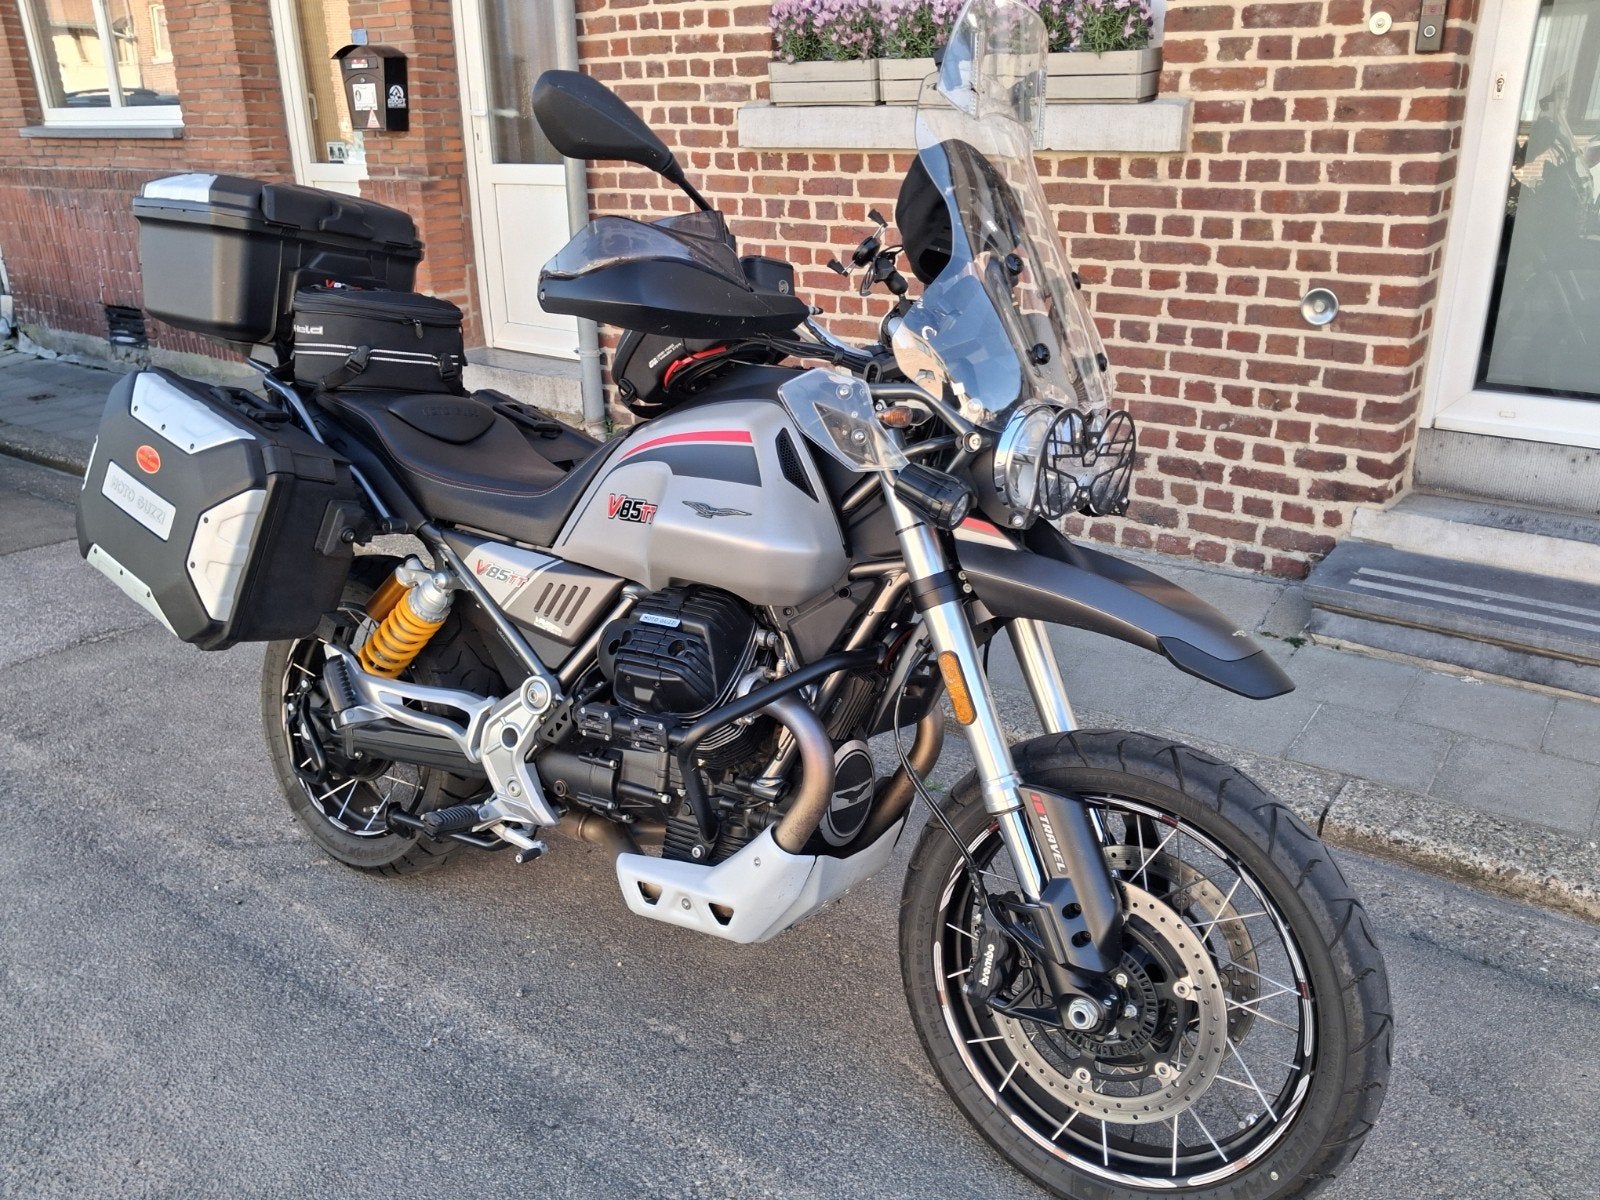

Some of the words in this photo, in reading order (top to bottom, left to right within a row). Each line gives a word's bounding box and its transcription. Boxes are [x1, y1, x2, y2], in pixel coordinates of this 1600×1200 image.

[607, 493, 658, 524] V85TT
[475, 559, 530, 588] V85TT
[1039, 814, 1066, 872] TRAVEL
[978, 943, 995, 987] brembo
